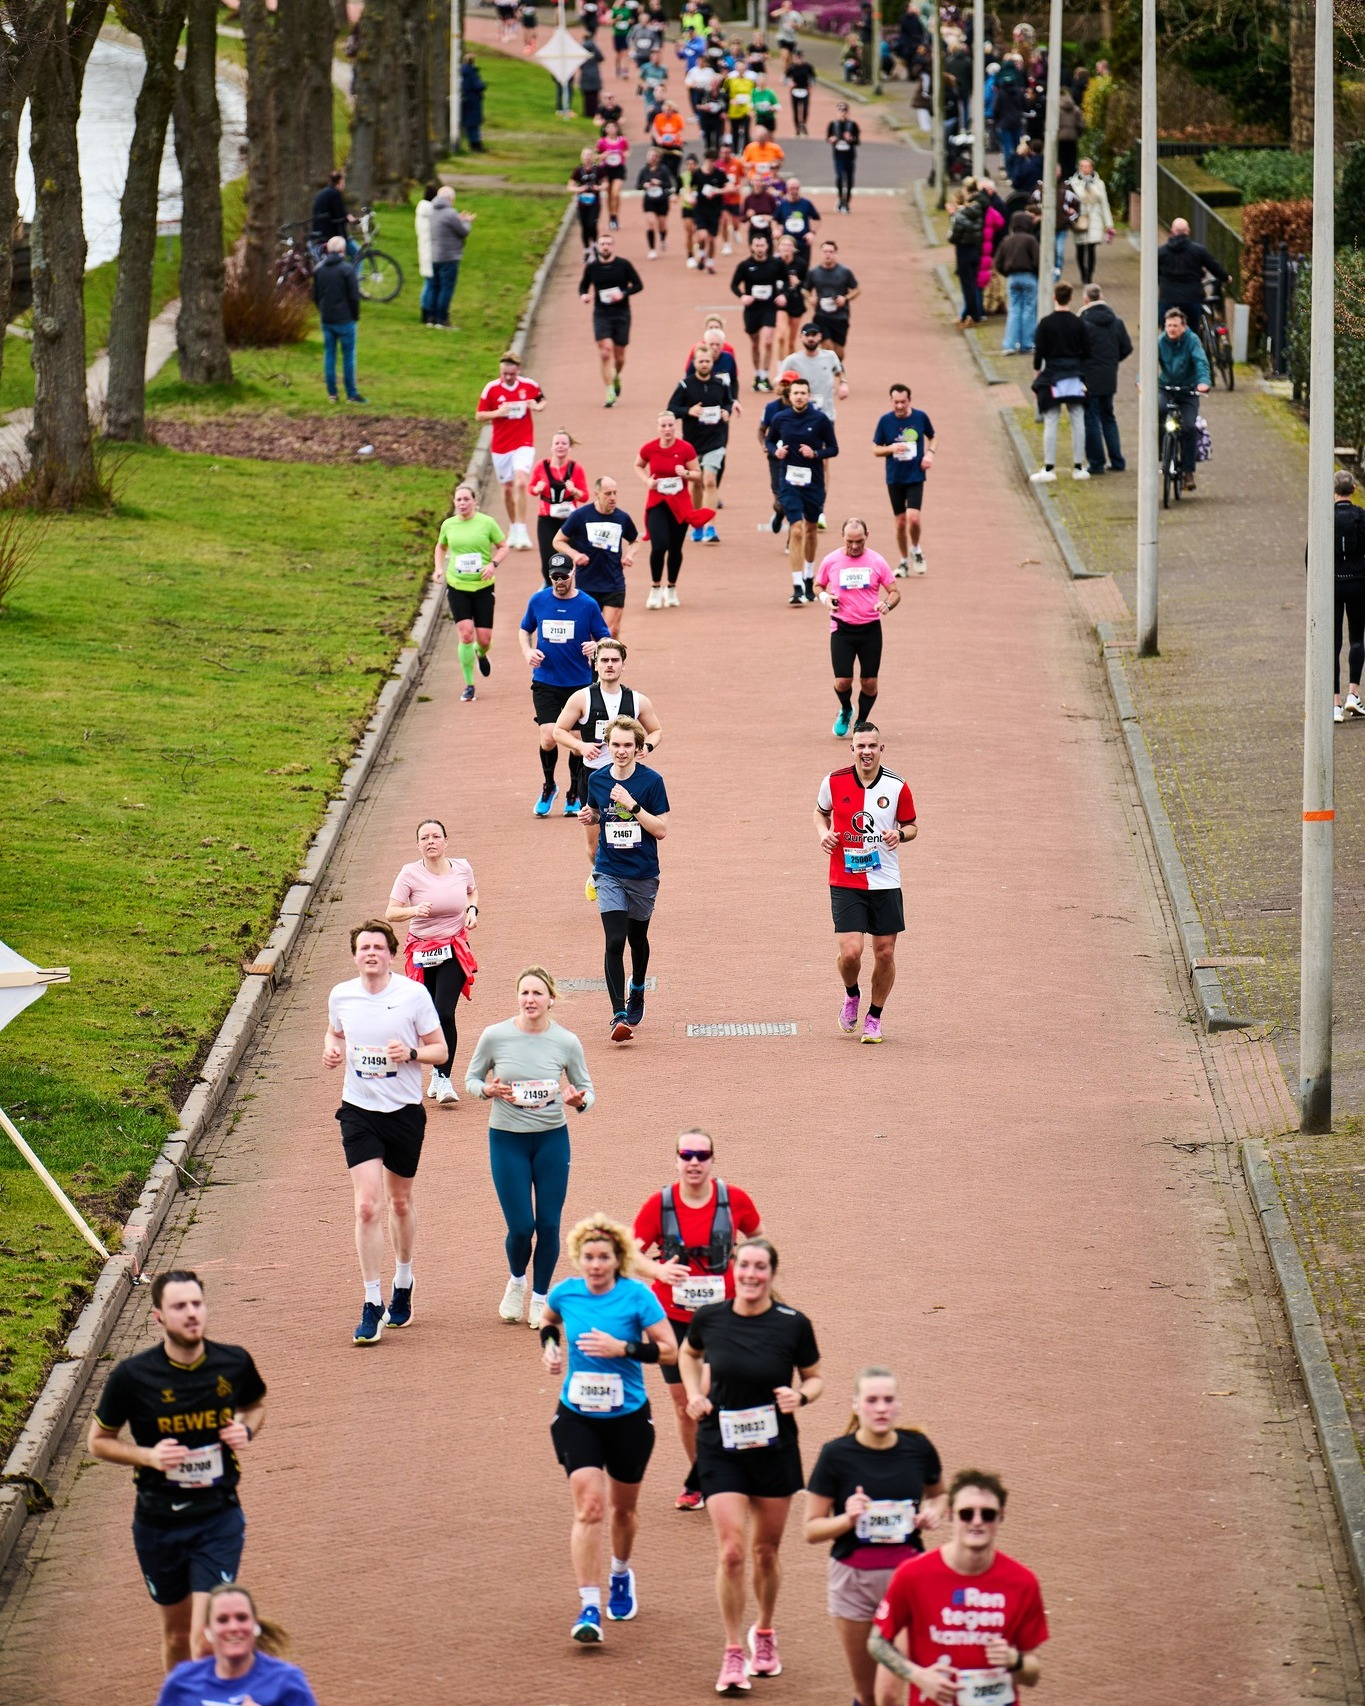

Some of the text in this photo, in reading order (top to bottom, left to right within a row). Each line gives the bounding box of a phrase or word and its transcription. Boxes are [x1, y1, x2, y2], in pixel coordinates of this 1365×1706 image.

[613, 830, 632, 839] 21467
[843, 831, 883, 843] Qurrent
[851, 855, 872, 864] 25008
[421, 947, 443, 958] 21220
[362, 1056, 387, 1066] 21494
[523, 1090, 549, 1100] 21493
[684, 1288, 714, 1299] 20459
[157, 1409, 217, 1433] REWE
[941, 1606, 1005, 1630] tegen
